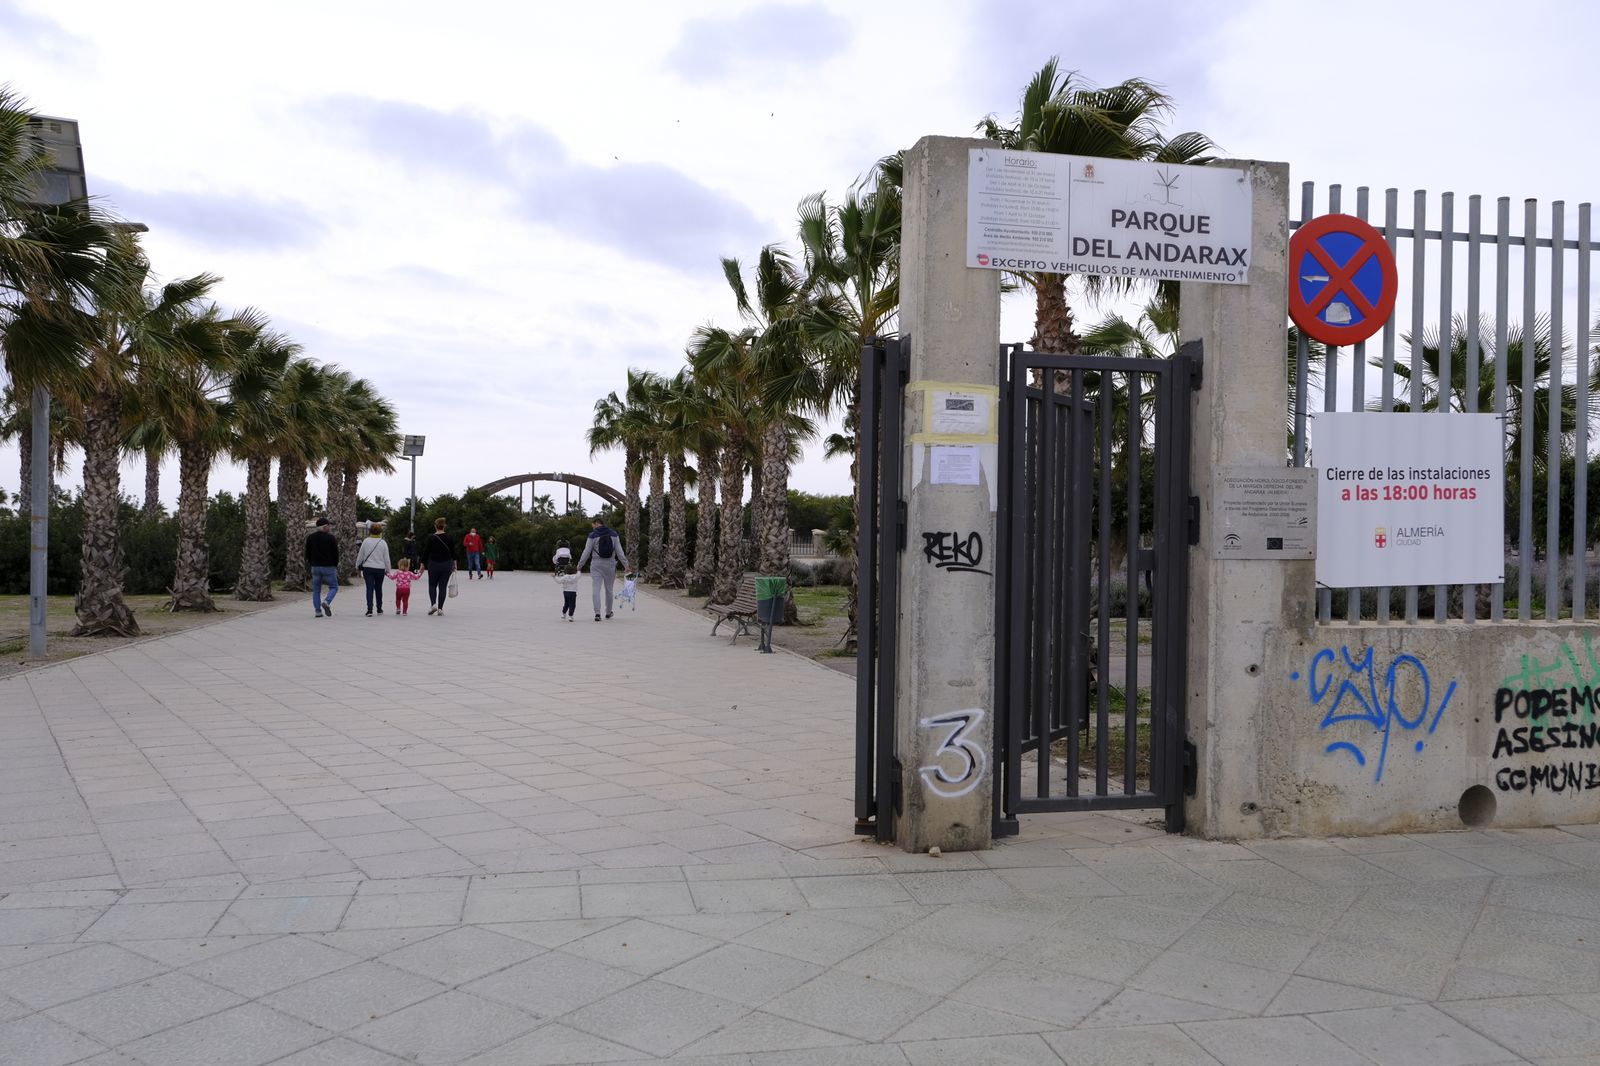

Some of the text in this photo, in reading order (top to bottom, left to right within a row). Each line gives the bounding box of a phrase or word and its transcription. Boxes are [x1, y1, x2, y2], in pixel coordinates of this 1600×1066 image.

[1005, 156, 1037, 166] Horario:
[1112, 209, 1210, 237] PARQUE
[1072, 238, 1248, 266] DEL ANDARAX
[992, 258, 1236, 282] EXCEPTO VEHICULOS DE MANTENIMIENTO
[1326, 467, 1490, 480] Cierre de las instalaciones
[1342, 484, 1476, 501] a las 18:00 horas
[1397, 525, 1444, 537] ALMERÍA
[1492, 722, 1600, 758] ASESIN
[920, 708, 986, 798] 3
